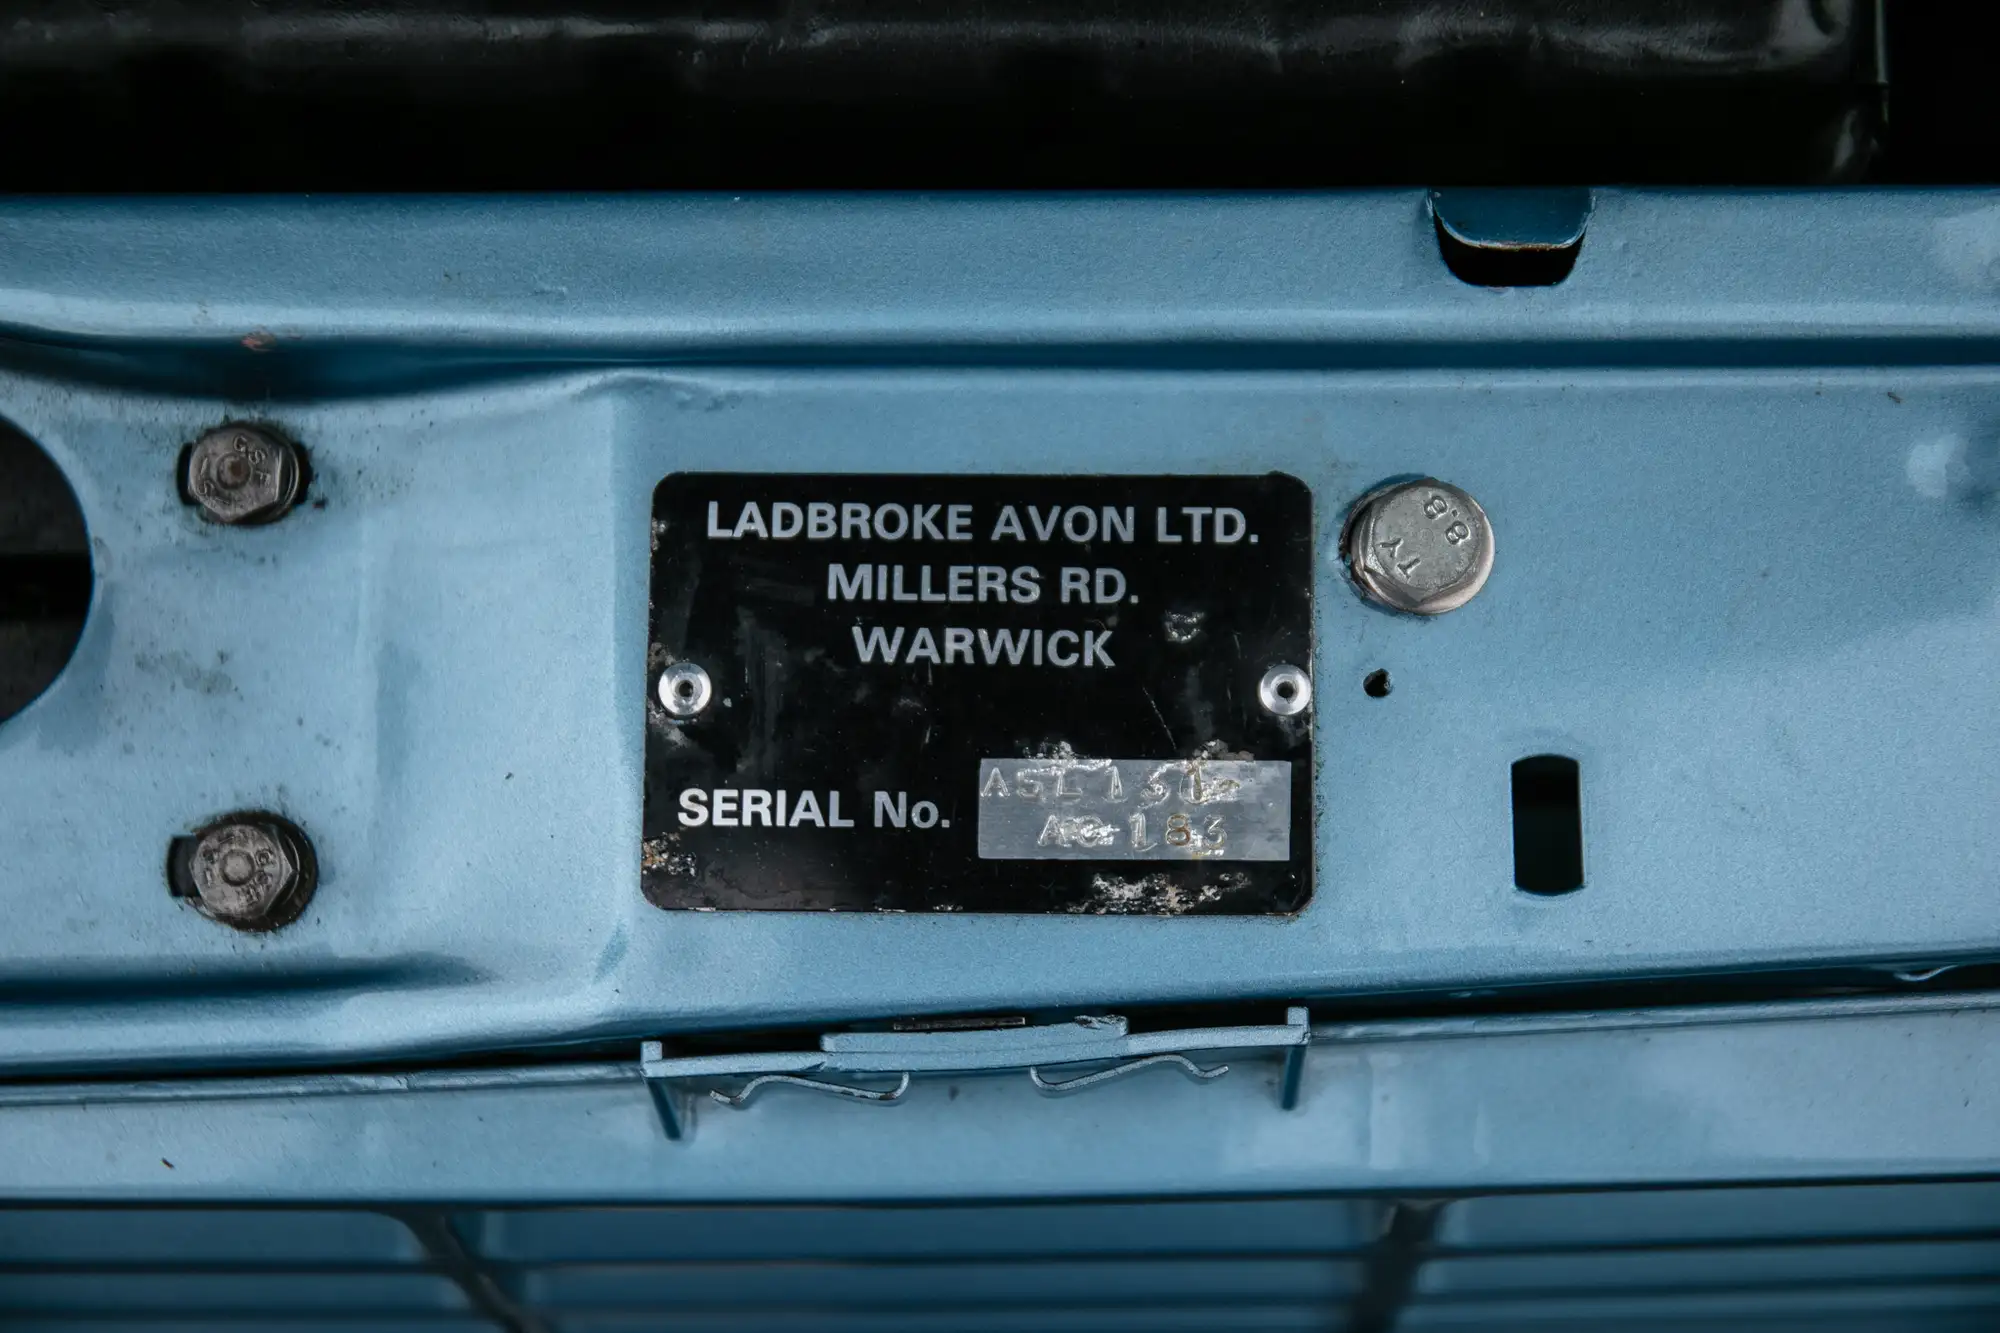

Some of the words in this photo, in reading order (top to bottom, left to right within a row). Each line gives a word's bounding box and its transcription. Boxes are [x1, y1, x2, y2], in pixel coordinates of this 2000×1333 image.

[707, 501, 972, 540] LADBROKE
[991, 505, 1134, 542] AVON
[1157, 507, 1258, 543] LTD.
[827, 563, 1041, 603] MILLERS
[1061, 567, 1138, 604] RD.
[851, 626, 1115, 667] WARWICK
[677, 787, 855, 828] SERIAL
[874, 790, 950, 828] No.
